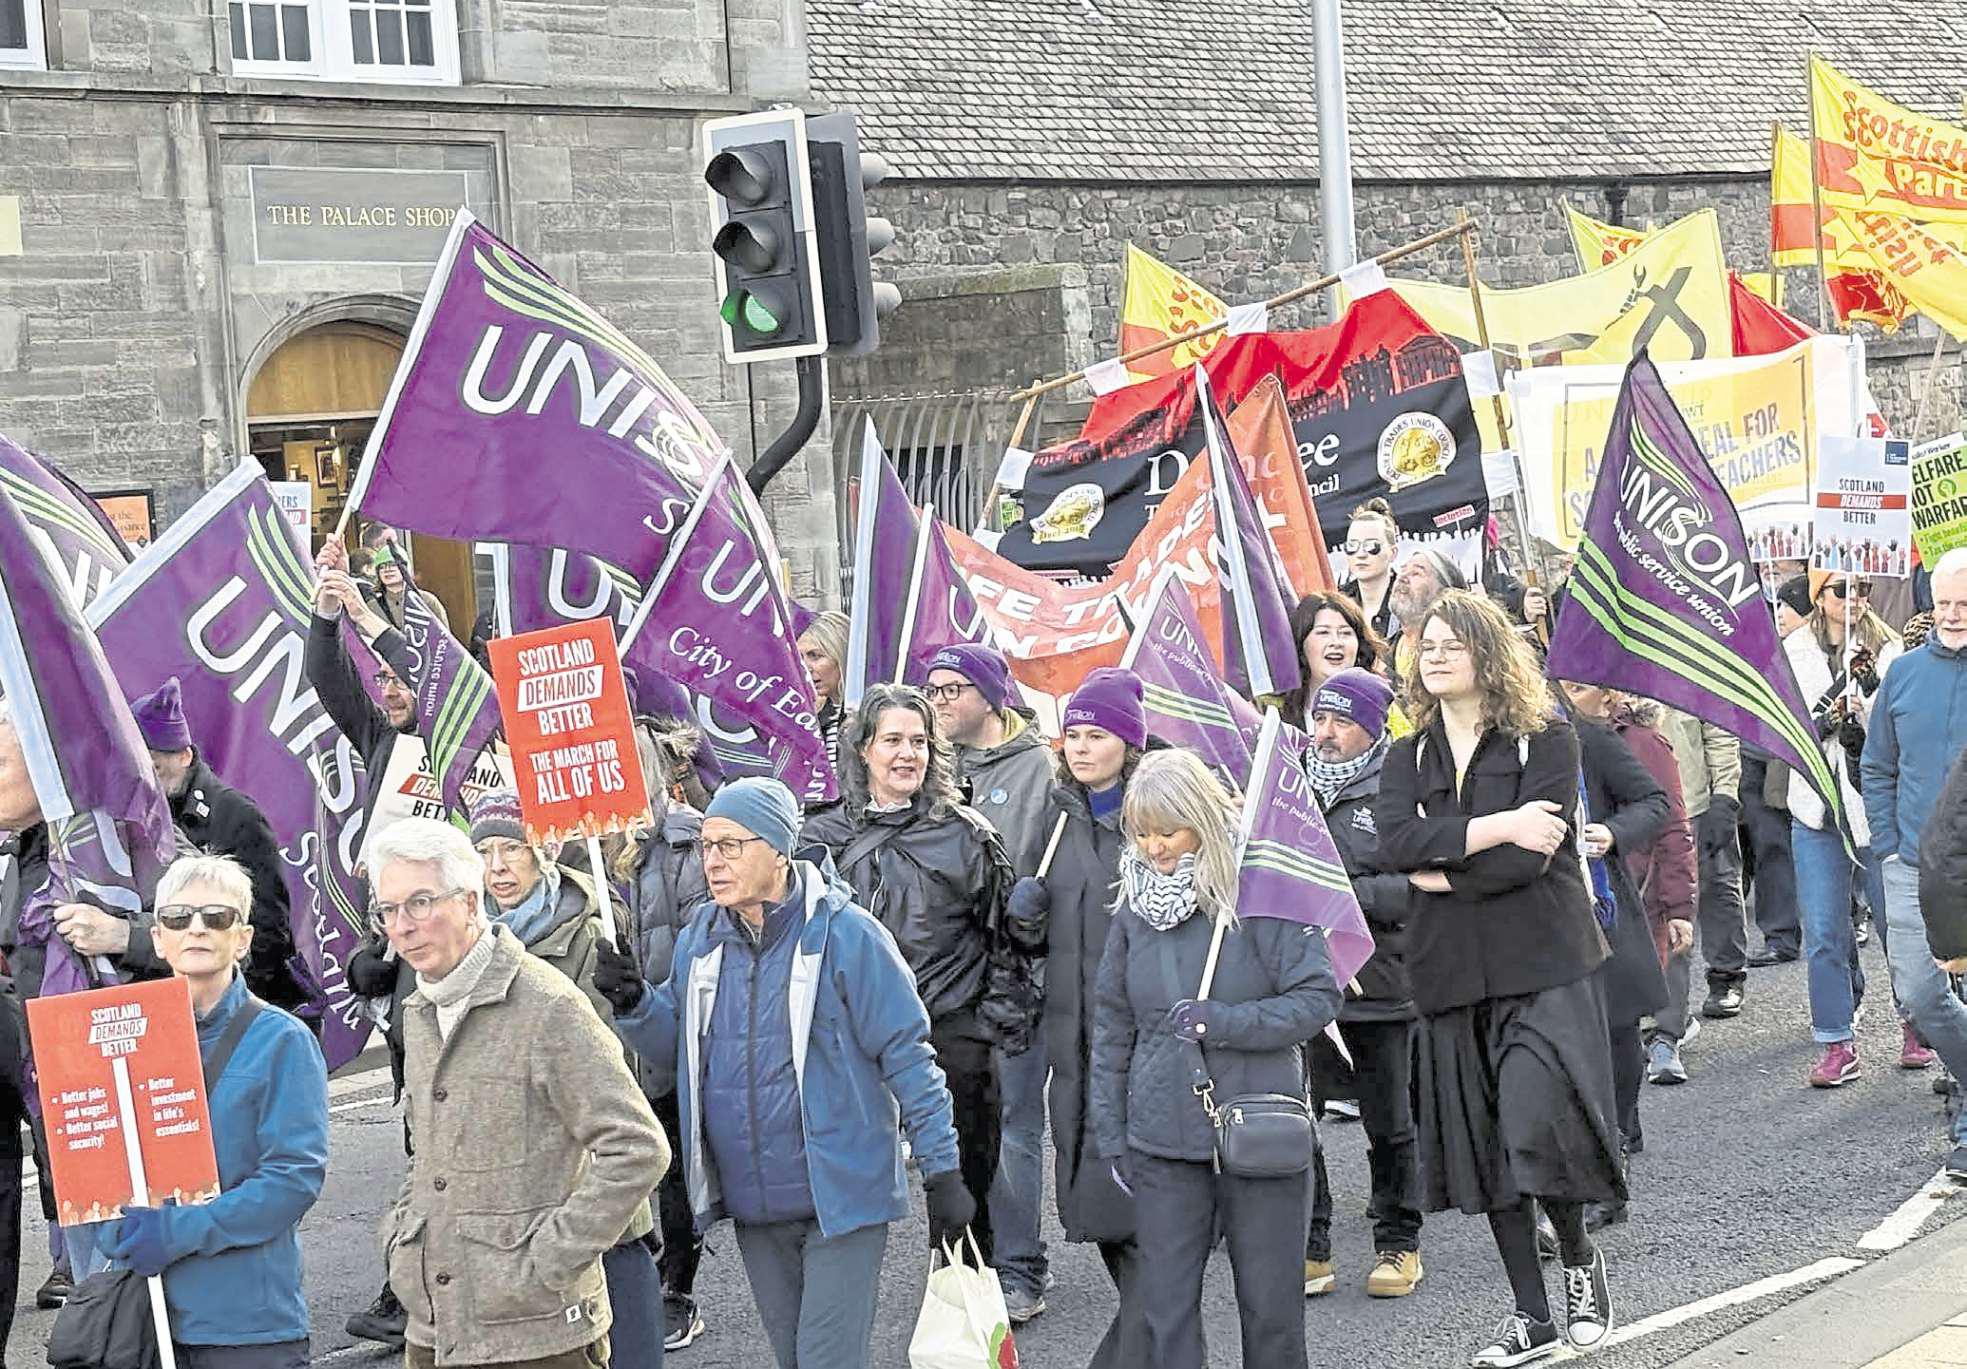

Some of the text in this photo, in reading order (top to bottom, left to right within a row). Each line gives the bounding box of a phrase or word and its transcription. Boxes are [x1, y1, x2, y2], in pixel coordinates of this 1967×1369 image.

[1898, 162, 1967, 200] Part
[267, 206, 456, 227] THE PALACE SHOP
[463, 325, 704, 477] UNIS
[1742, 402, 1780, 443] FOR
[1585, 420, 1740, 482] A EAL
[1719, 430, 1802, 488] EACHERS
[1912, 450, 1964, 486] ELFARE
[1839, 478, 1885, 493] SCOTLAND
[1620, 454, 1760, 607] UNISON
[1843, 510, 1877, 525] BETTER
[1911, 496, 1967, 530] WARFA
[1638, 552, 1691, 596] service
[1686, 594, 1735, 636] union
[517, 638, 595, 676] SCOTLAND
[669, 626, 784, 703] City of
[525, 670, 596, 706] DEMANDS
[187, 575, 363, 877] UNIS
[537, 702, 594, 737] BETTER
[529, 739, 619, 773] THE MARCH FOR
[536, 760, 626, 805] ALL OF US
[90, 1003, 142, 1024] SCOTLAND
[95, 1020, 143, 1040] DEMANDS
[101, 1037, 138, 1057] BETTER
[61, 1087, 107, 1105] Better jobs
[148, 1077, 175, 1091] Better
[64, 1106, 80, 1120] and
[66, 1116, 119, 1136] Better social
[153, 1106, 185, 1122] in life's
